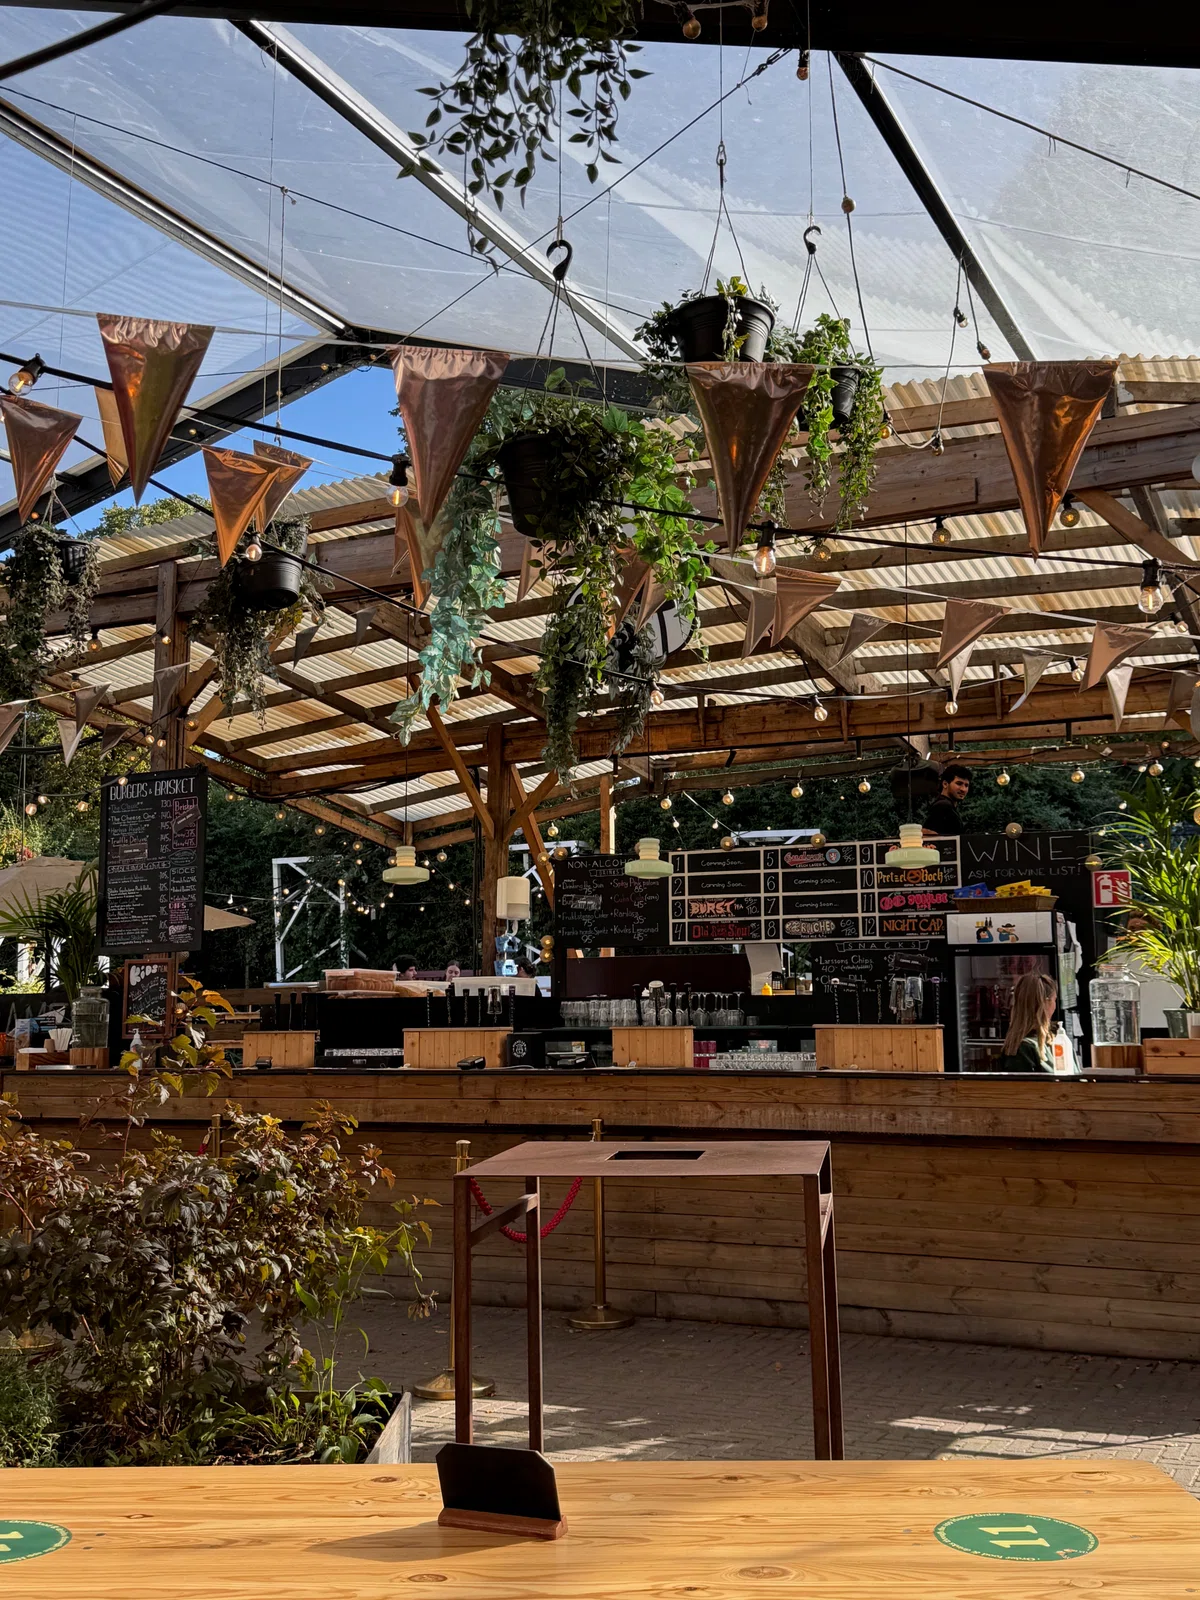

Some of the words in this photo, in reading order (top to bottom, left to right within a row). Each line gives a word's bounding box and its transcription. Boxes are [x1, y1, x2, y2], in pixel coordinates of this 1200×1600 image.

[109, 782, 149, 801] BURGERS
[154, 777, 196, 797] BRISKET
[111, 815, 121, 823] The
[121, 812, 142, 822] Cheese
[143, 812, 156, 820] One
[861, 846, 871, 864] 9
[967, 835, 1076, 863] WINE
[675, 856, 681, 872] 1
[766, 851, 775, 868] 5
[862, 869, 874, 888] 10
[967, 870, 993, 880] ASK
[995, 867, 1015, 879] FOR
[1018, 866, 1046, 877] WINE
[1049, 864, 1081, 877] LIST!
[674, 877, 683, 895] 2
[766, 875, 776, 892] 6
[674, 900, 683, 918] 3
[688, 898, 738, 918] BURST
[766, 897, 777, 914] 7
[863, 893, 873, 912] 11
[674, 922, 683, 941] 4
[692, 925, 709, 939] Old
[767, 920, 776, 938] 8
[864, 917, 876, 936] 12
[882, 918, 918, 932] NIGHT
[819, 956, 849, 966] Larssons
